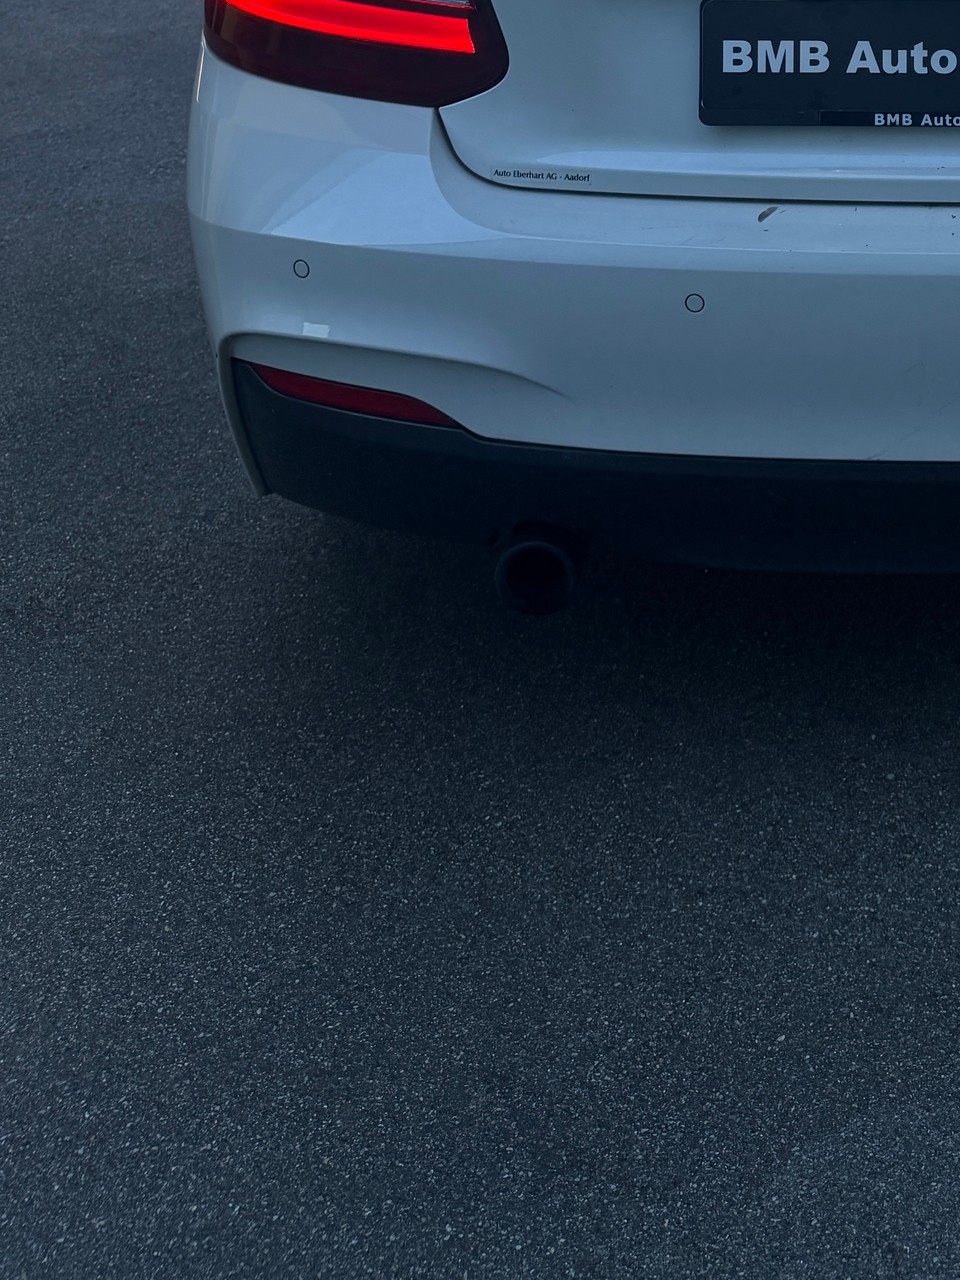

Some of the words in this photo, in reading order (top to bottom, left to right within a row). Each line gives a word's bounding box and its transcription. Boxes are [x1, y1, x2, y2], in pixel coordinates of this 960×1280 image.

[722, 39, 830, 74] BMB
[873, 113, 913, 126] BMB
[493, 169, 511, 177] Auto
[513, 170, 544, 180] Eberhart
[564, 173, 590, 182] Aadorf
